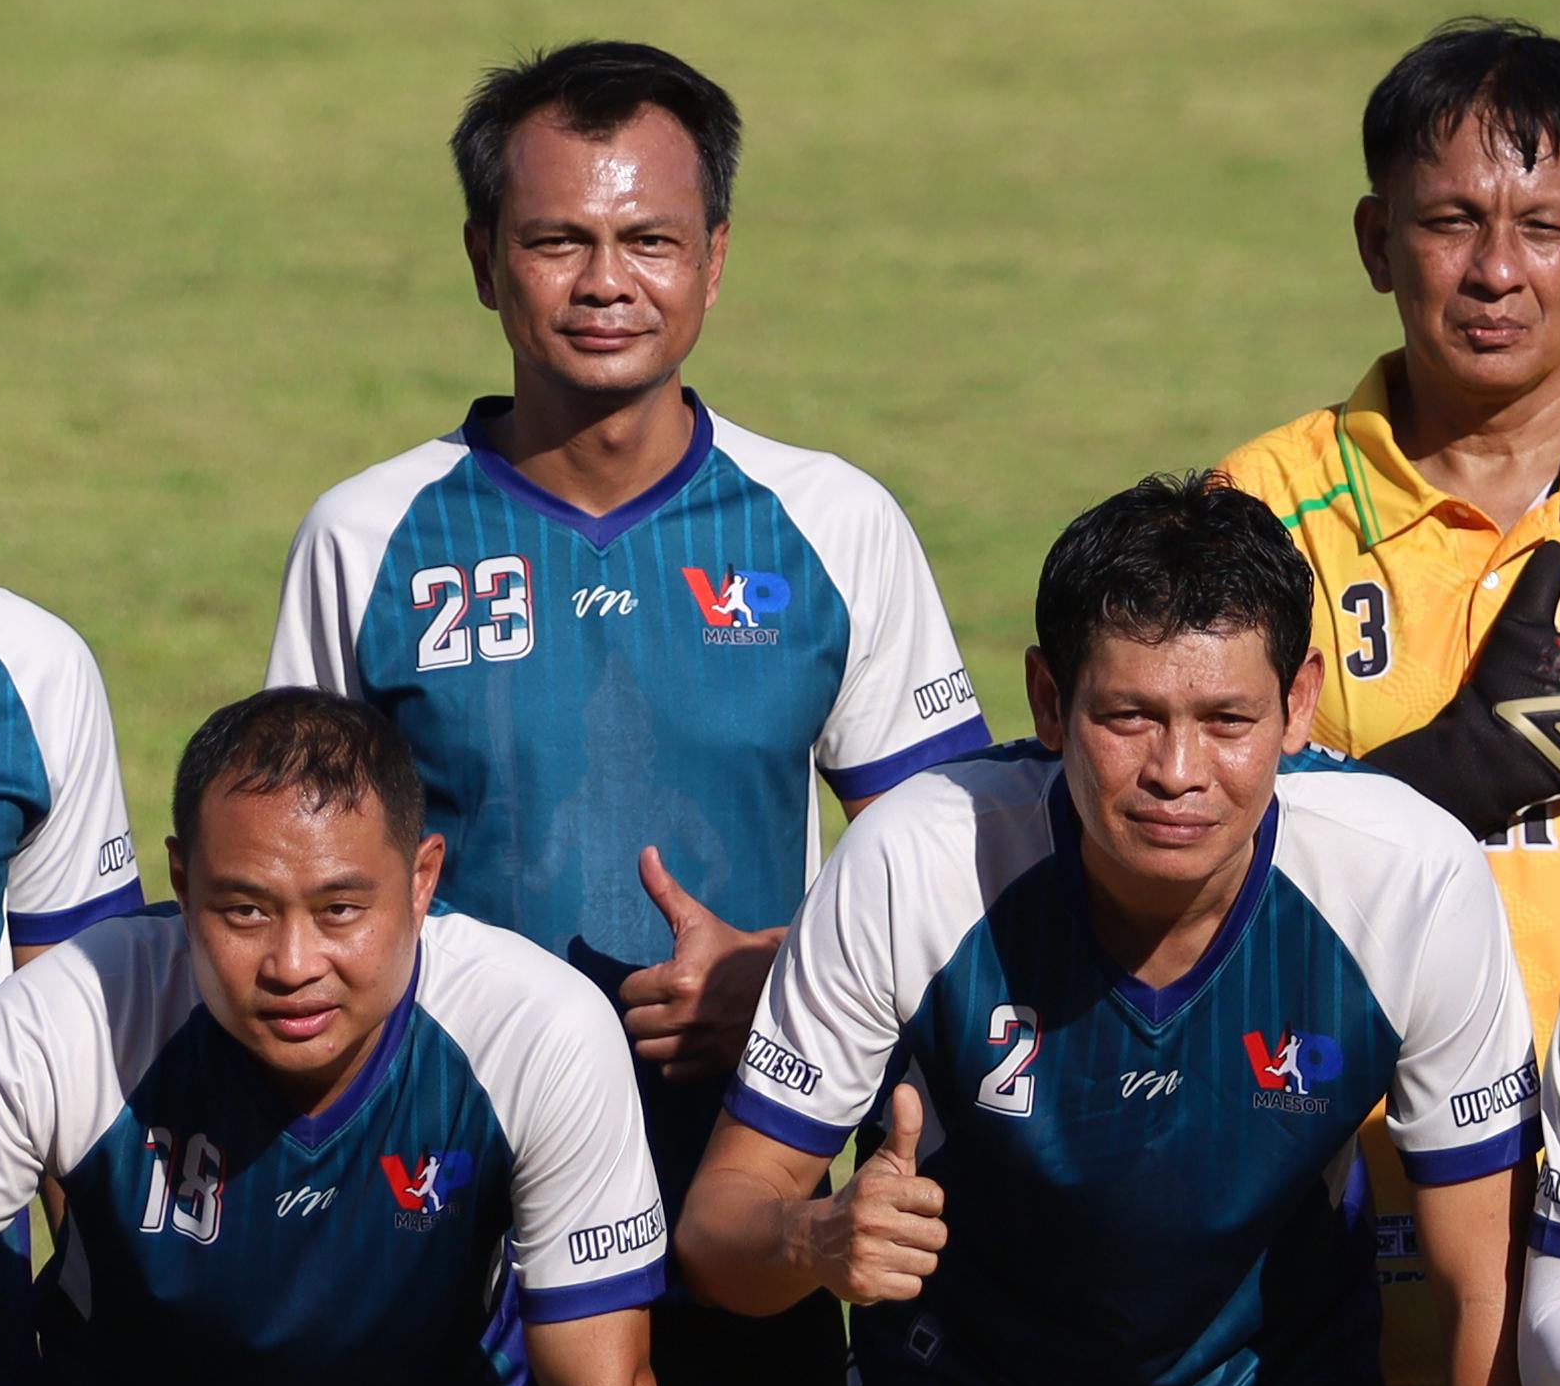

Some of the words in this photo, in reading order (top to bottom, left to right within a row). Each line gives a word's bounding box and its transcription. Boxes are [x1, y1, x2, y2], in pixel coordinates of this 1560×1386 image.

[410, 553, 535, 672] 23
[1341, 582, 1392, 680] 3
[702, 628, 780, 646] MAESOT
[914, 680, 953, 720] VIP
[97, 836, 128, 877] VIP
[974, 1003, 1043, 1118] 2
[1253, 1092, 1330, 1114] MAESOT
[1450, 1085, 1494, 1129] VIP
[138, 1126, 226, 1245] 18
[568, 1226, 614, 1265] VIP
